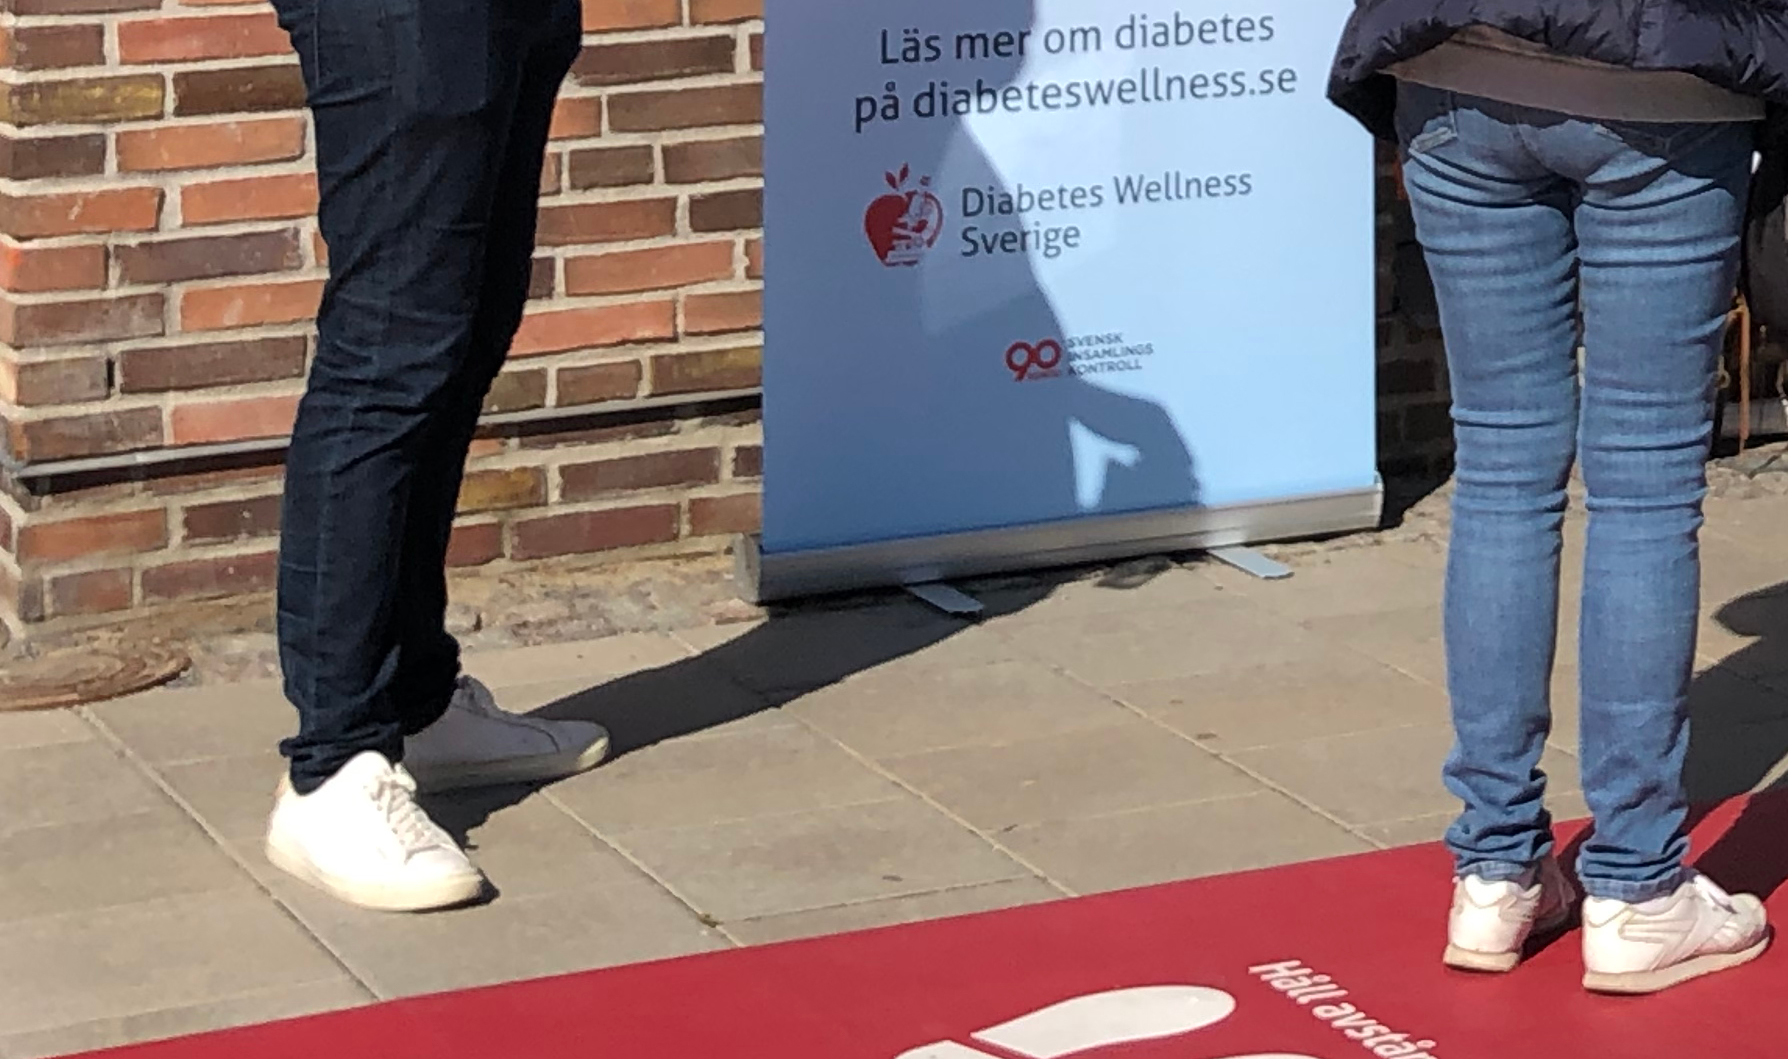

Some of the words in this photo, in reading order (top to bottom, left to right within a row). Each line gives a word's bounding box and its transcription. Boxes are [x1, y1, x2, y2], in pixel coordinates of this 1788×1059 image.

[878, 25, 943, 66] Läs
[954, 31, 1031, 60] mer
[1043, 24, 1102, 54] om
[1114, 11, 1277, 51] diabetes
[853, 86, 902, 134] på
[913, 63, 1299, 120] diabeteswellness.se
[961, 177, 1105, 219] Diabetes
[1113, 168, 1253, 204] Wellness
[961, 222, 1082, 260] Sverige
[1005, 338, 1062, 382] 90
[1067, 332, 1124, 348] SVENSK
[1068, 359, 1143, 376] KONTROLL
[1248, 959, 1350, 1005] Håll
[1311, 1002, 1440, 1059] avstå
